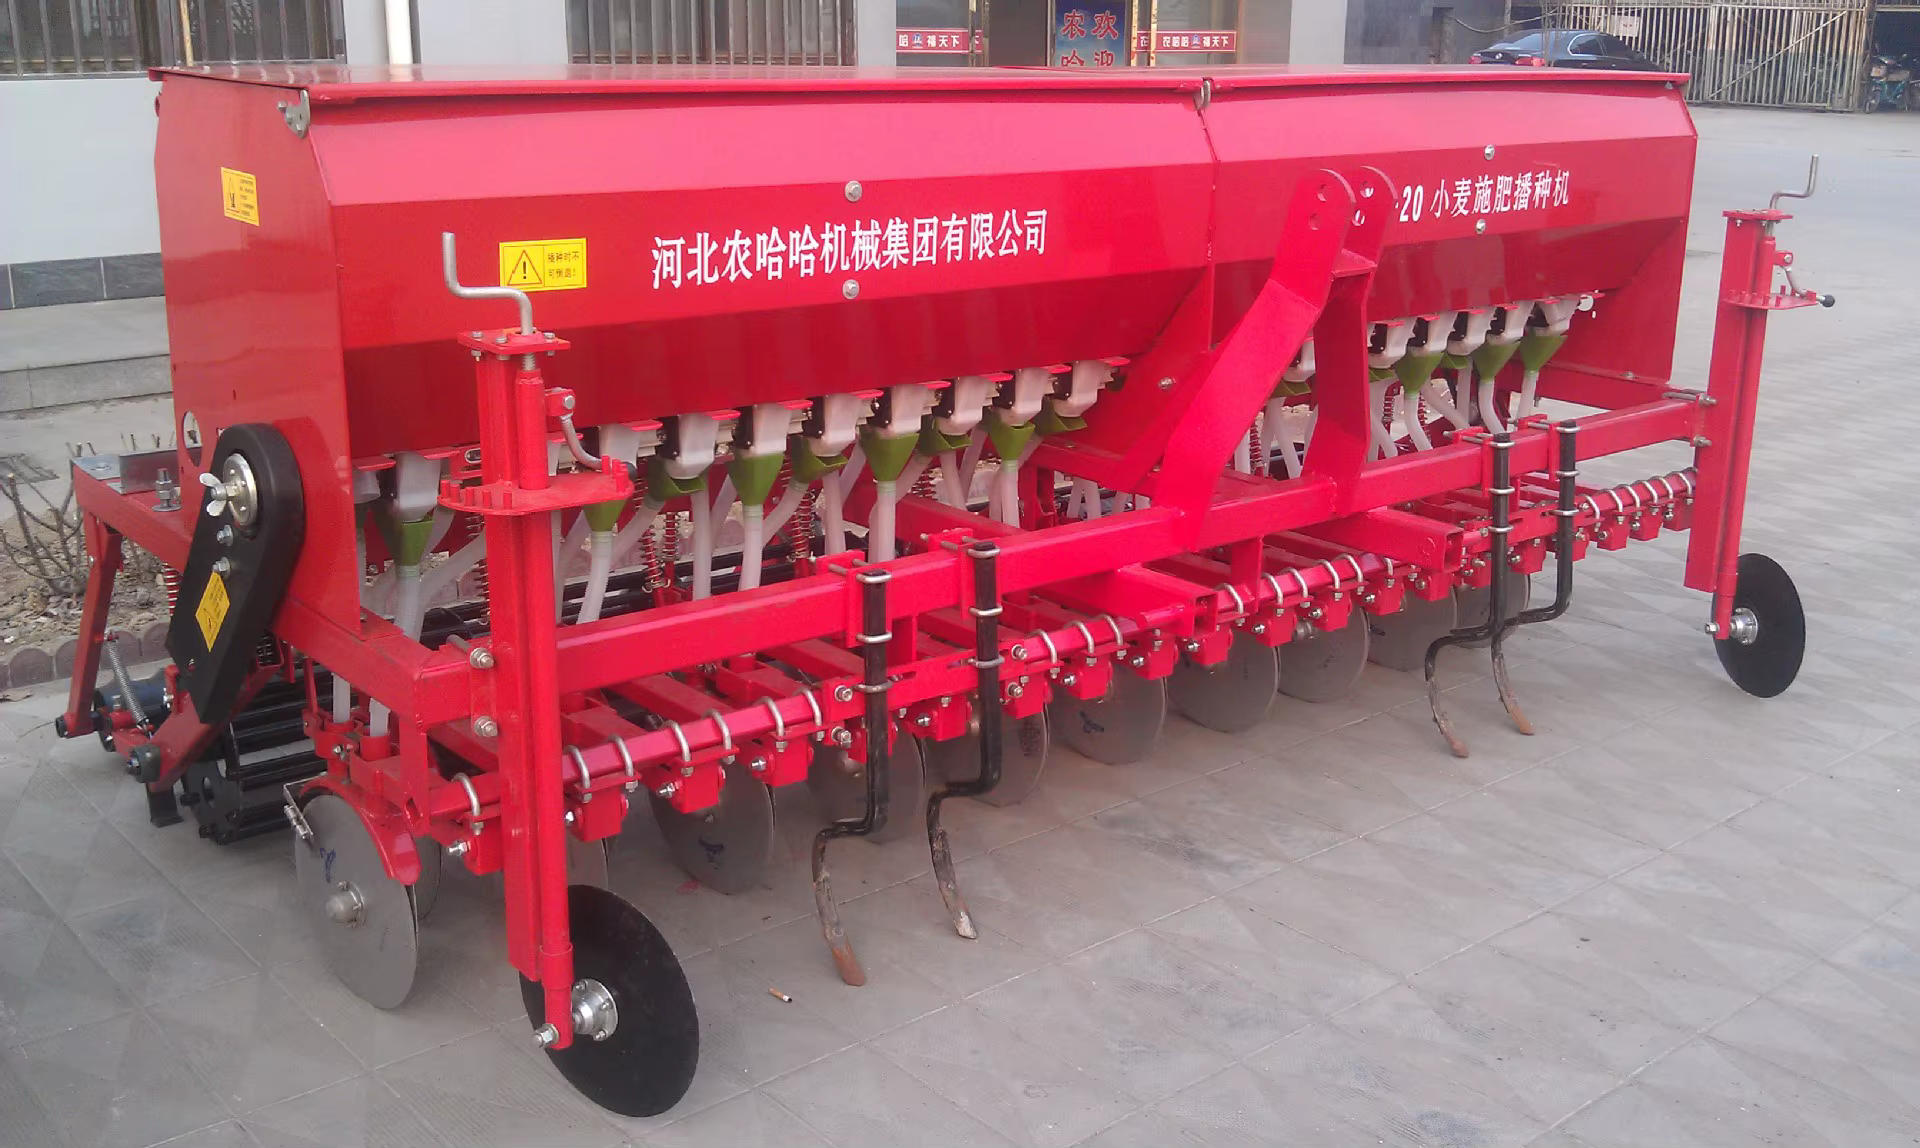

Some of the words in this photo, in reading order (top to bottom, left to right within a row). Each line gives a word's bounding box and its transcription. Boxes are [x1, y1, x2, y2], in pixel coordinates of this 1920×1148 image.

[1430, 170, 1570, 218] 小麦施肥播种机
[652, 209, 1048, 289] 河北农哈哈机械集团有限公司
